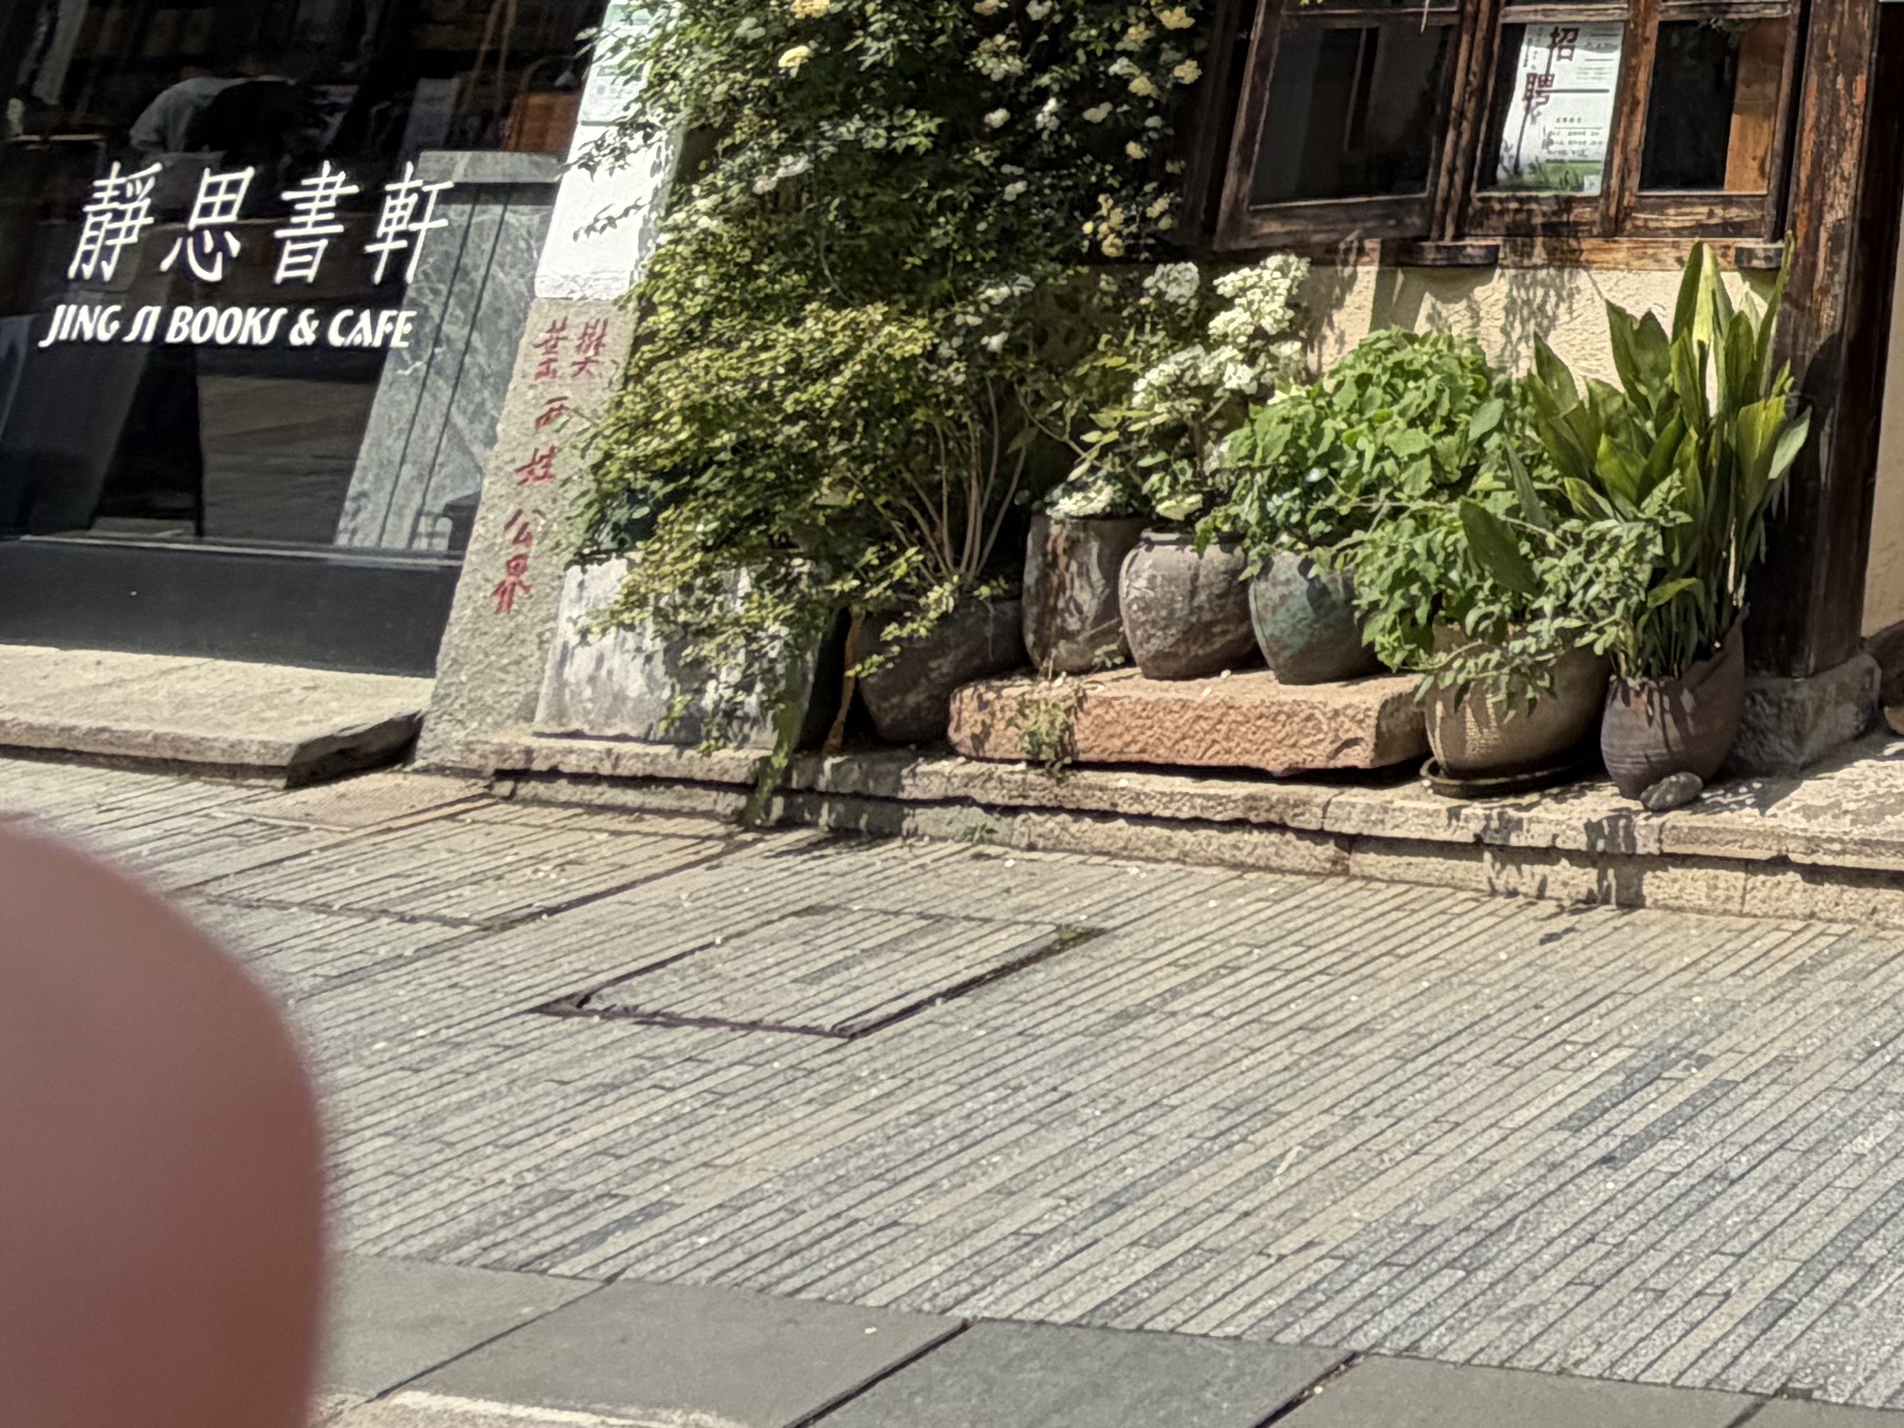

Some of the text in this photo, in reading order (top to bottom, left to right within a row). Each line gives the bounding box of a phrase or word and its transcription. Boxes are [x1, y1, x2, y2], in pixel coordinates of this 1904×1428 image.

[1521, 26, 1580, 125] 招聘
[68, 160, 454, 285] 靜思書軒
[38, 304, 120, 349] JING
[165, 306, 288, 345] BOOKS
[289, 308, 318, 347] &
[327, 309, 417, 348] CAFE
